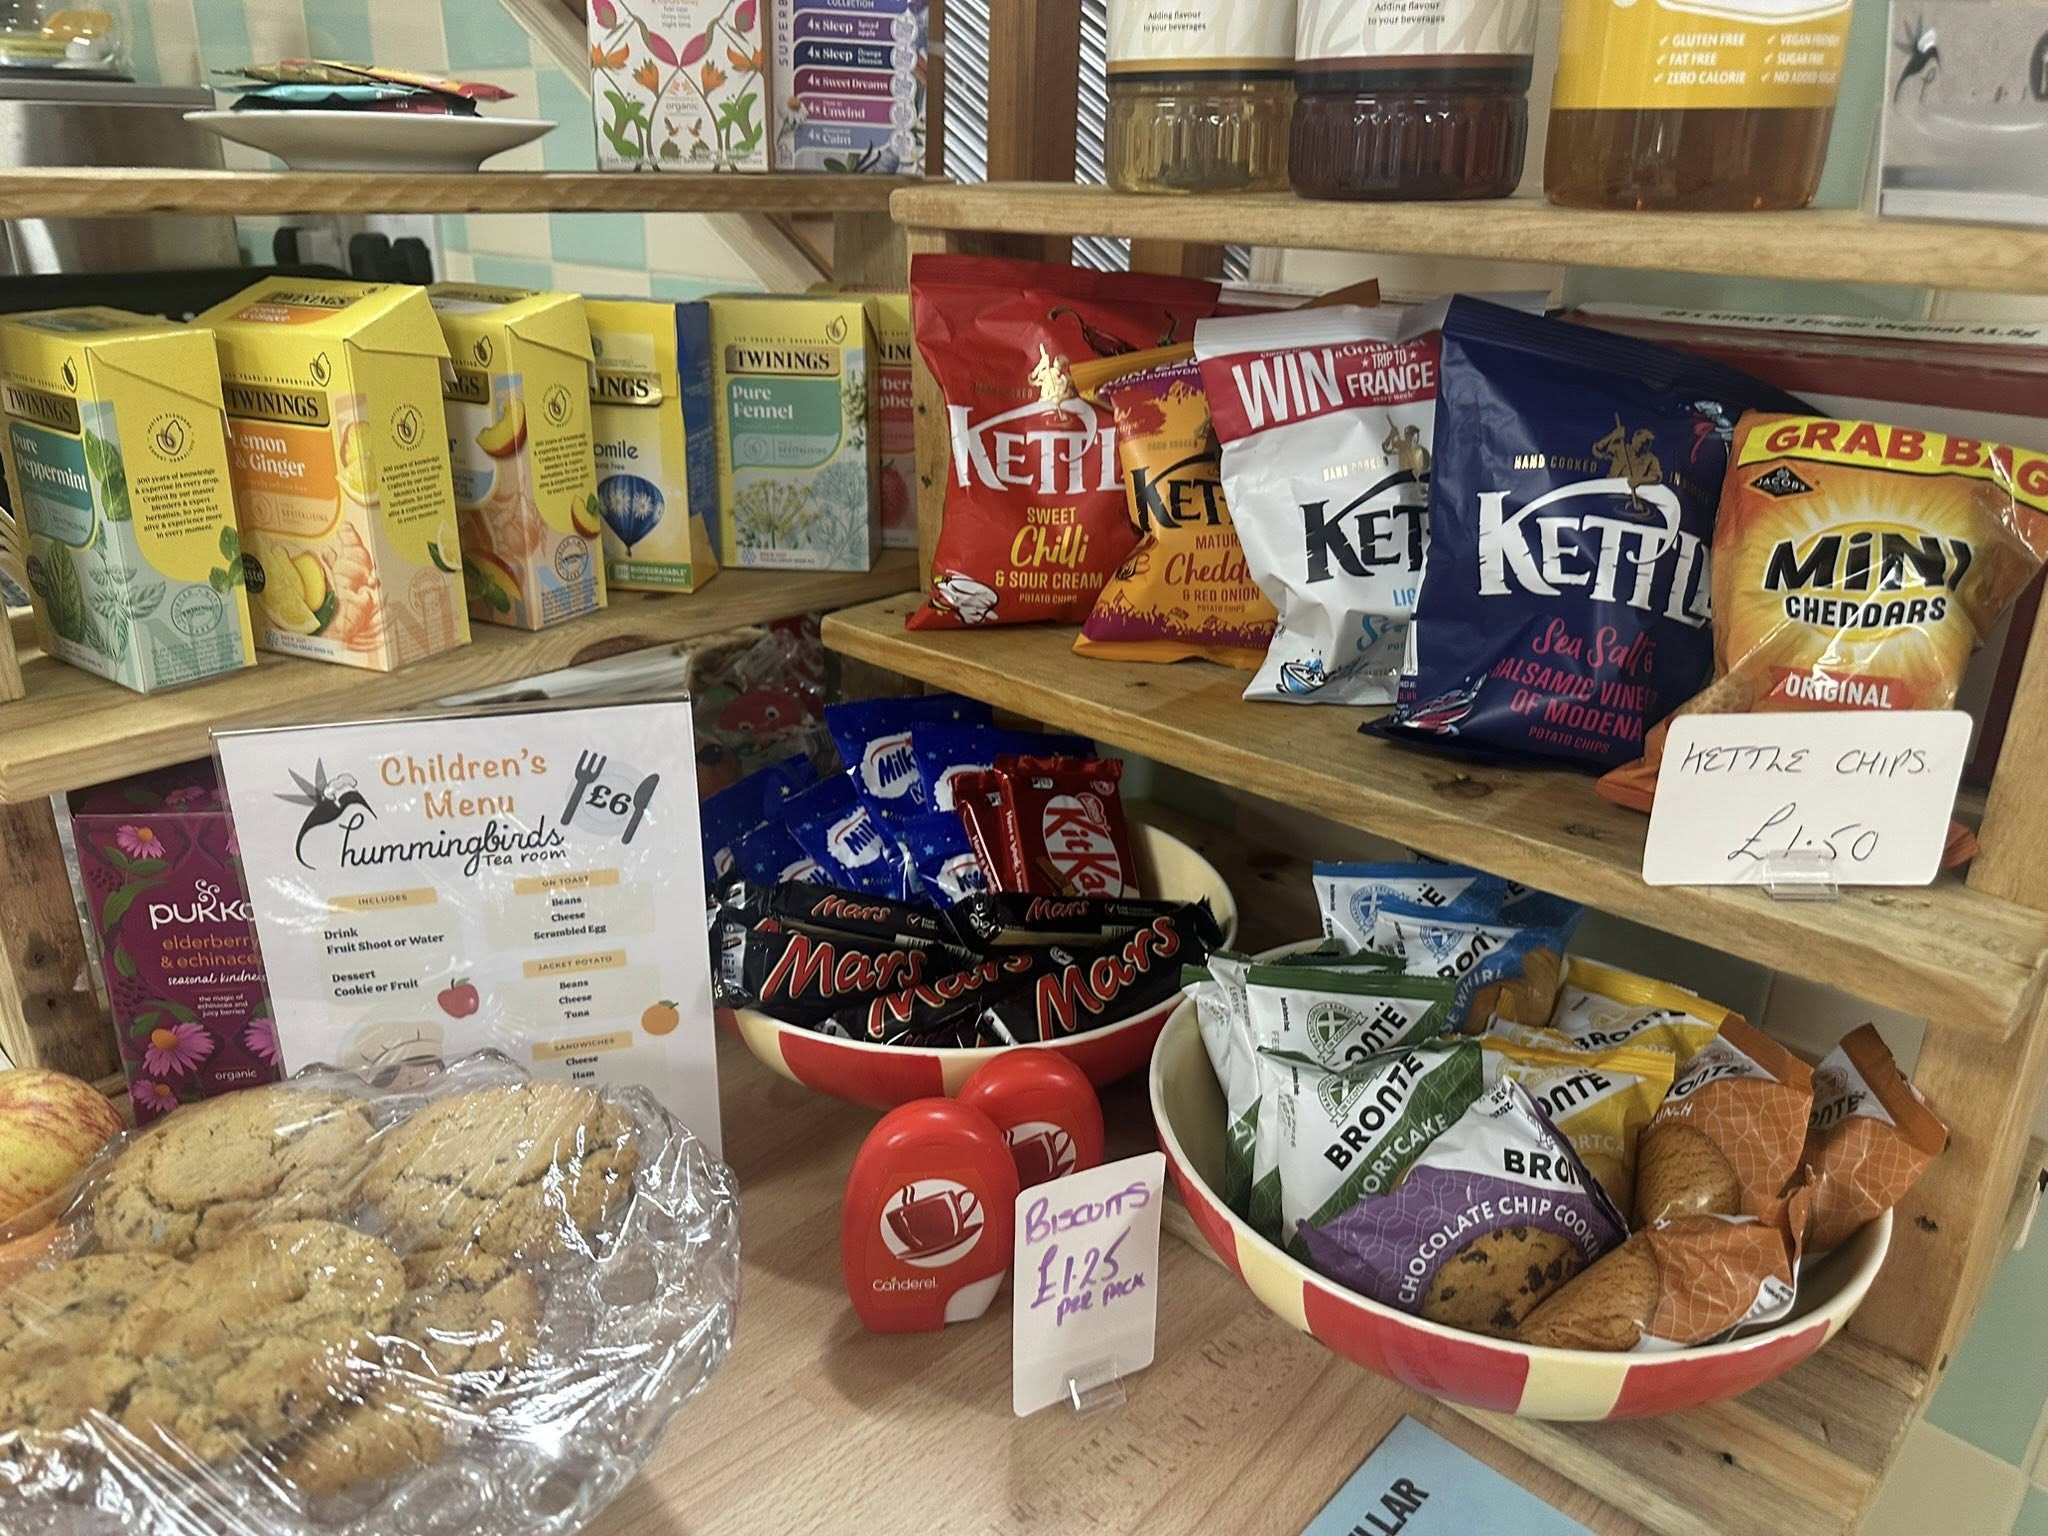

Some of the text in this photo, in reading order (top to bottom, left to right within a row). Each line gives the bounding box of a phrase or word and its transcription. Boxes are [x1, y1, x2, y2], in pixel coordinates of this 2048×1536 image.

[1147, 11, 1172, 21] Adding
[1374, 2, 1406, 13] Adding
[823, 19, 853, 34] Sleep
[1379, 17, 1398, 27] your
[1400, 14, 1445, 25] beverages
[1672, 33, 1745, 47] GLUTEN FREE
[1780, 34, 1811, 47] VEGAN
[823, 48, 853, 62] Sleep
[1669, 53, 1717, 66] FAT FREE
[1778, 53, 1807, 65] SUGAR
[852, 79, 888, 90] Dreams
[1667, 72, 1697, 85] ZERO
[823, 106, 866, 119] Unwind
[823, 133, 851, 145] Calm
[737, 350, 829, 369] TWININGS
[1371, 350, 1407, 369] TRIP TO
[1147, 366, 1202, 381] EVERYDA
[1346, 361, 1435, 398] FRANCE
[590, 378, 649, 399] INGS
[732, 385, 771, 400] Pure
[1232, 348, 1344, 430] WIN
[6, 387, 73, 424] TWININGS
[231, 388, 318, 418] TWININGS
[733, 402, 793, 420] Fennel
[12, 431, 39, 454] Pure
[232, 432, 287, 454] Lemon
[235, 451, 305, 477] & Ginger
[1514, 454, 1598, 473] HAND COOKED
[1766, 422, 2048, 496] GRAB BAG
[15, 453, 88, 492] Peppermint
[1130, 455, 1235, 533] KET
[1027, 506, 1077, 525] SWEET
[1300, 470, 1431, 584] KET
[1010, 524, 1089, 569] Chilli
[1195, 533, 1241, 551] MATUR
[995, 570, 1103, 590] & SOUR CREAM
[1019, 593, 1050, 604] POTATO
[1194, 587, 1260, 601] RED ONION
[1785, 595, 1947, 628] CHEDDARS
[1532, 617, 1652, 677] Sea Salt
[1600, 680, 1657, 713] VINE
[1785, 672, 1892, 708] ORIGINAL
[1510, 688, 1642, 742] OF MODENA
[1529, 726, 1610, 753] POTATO CHIPS
[1680, 742, 1810, 774] KETTLE
[424, 791, 515, 820] Menu
[586, 785, 633, 816] £6
[339, 812, 565, 877] hummingbirds
[844, 820, 879, 857] Mil
[483, 849, 567, 868] Tea room
[1044, 807, 1122, 899] KitKa
[559, 875, 589, 886] TOAST
[358, 893, 408, 906] INCLUDES
[551, 896, 582, 907] Beans
[811, 895, 891, 923] Mars
[551, 911, 586, 922] Cheese
[1026, 897, 1090, 923] Mars
[324, 927, 359, 940] Drink
[534, 924, 607, 940] Scrambled Egg
[327, 934, 445, 955] Fruit Shoot or Water
[160, 952, 262, 969] & echinace
[538, 956, 612, 971] JACKET POTATO
[760, 935, 927, 1001] Mars
[168, 972, 217, 986] seasonal
[332, 970, 377, 983] Dessert
[559, 979, 589, 990] Beans
[1037, 916, 1180, 1042] Mars
[334, 978, 419, 997] Cookie or Fruit
[558, 994, 593, 1005] Cheese
[564, 1009, 590, 1019] Tuna
[554, 1037, 615, 1052] SANDWICHES
[565, 1056, 599, 1067] Cheese
[215, 1070, 257, 1081] organic
[572, 1070, 595, 1080] Ham
[1504, 1149, 1581, 1186] BRO
[1399, 1201, 1494, 1303] CHOCOLATE
[1499, 1196, 1551, 1216] CHIP
[872, 1277, 937, 1290] Canderel
[1347, 1477, 1430, 1536] LAR
